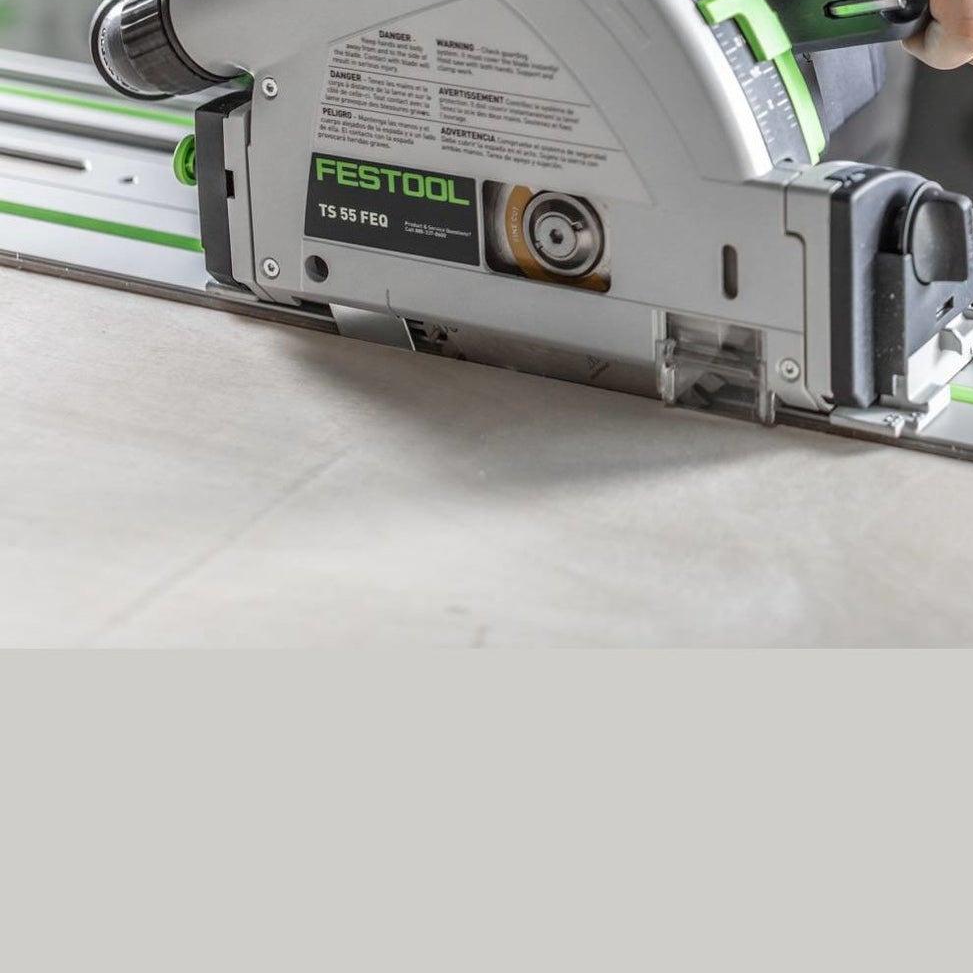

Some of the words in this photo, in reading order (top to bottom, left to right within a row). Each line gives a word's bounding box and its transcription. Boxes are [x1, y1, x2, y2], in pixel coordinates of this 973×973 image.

[379, 31, 412, 42] DANGER
[436, 38, 474, 51] WARNING
[330, 70, 361, 82] DANGER
[439, 87, 504, 103] AVERTISSEMENT
[322, 107, 352, 119] PELIGRO
[440, 127, 496, 142] ADVERTENCIA
[315, 158, 470, 206] FESTOOL
[319, 203, 337, 218] TS
[340, 207, 357, 222] 55
[360, 211, 389, 228] FEQ
